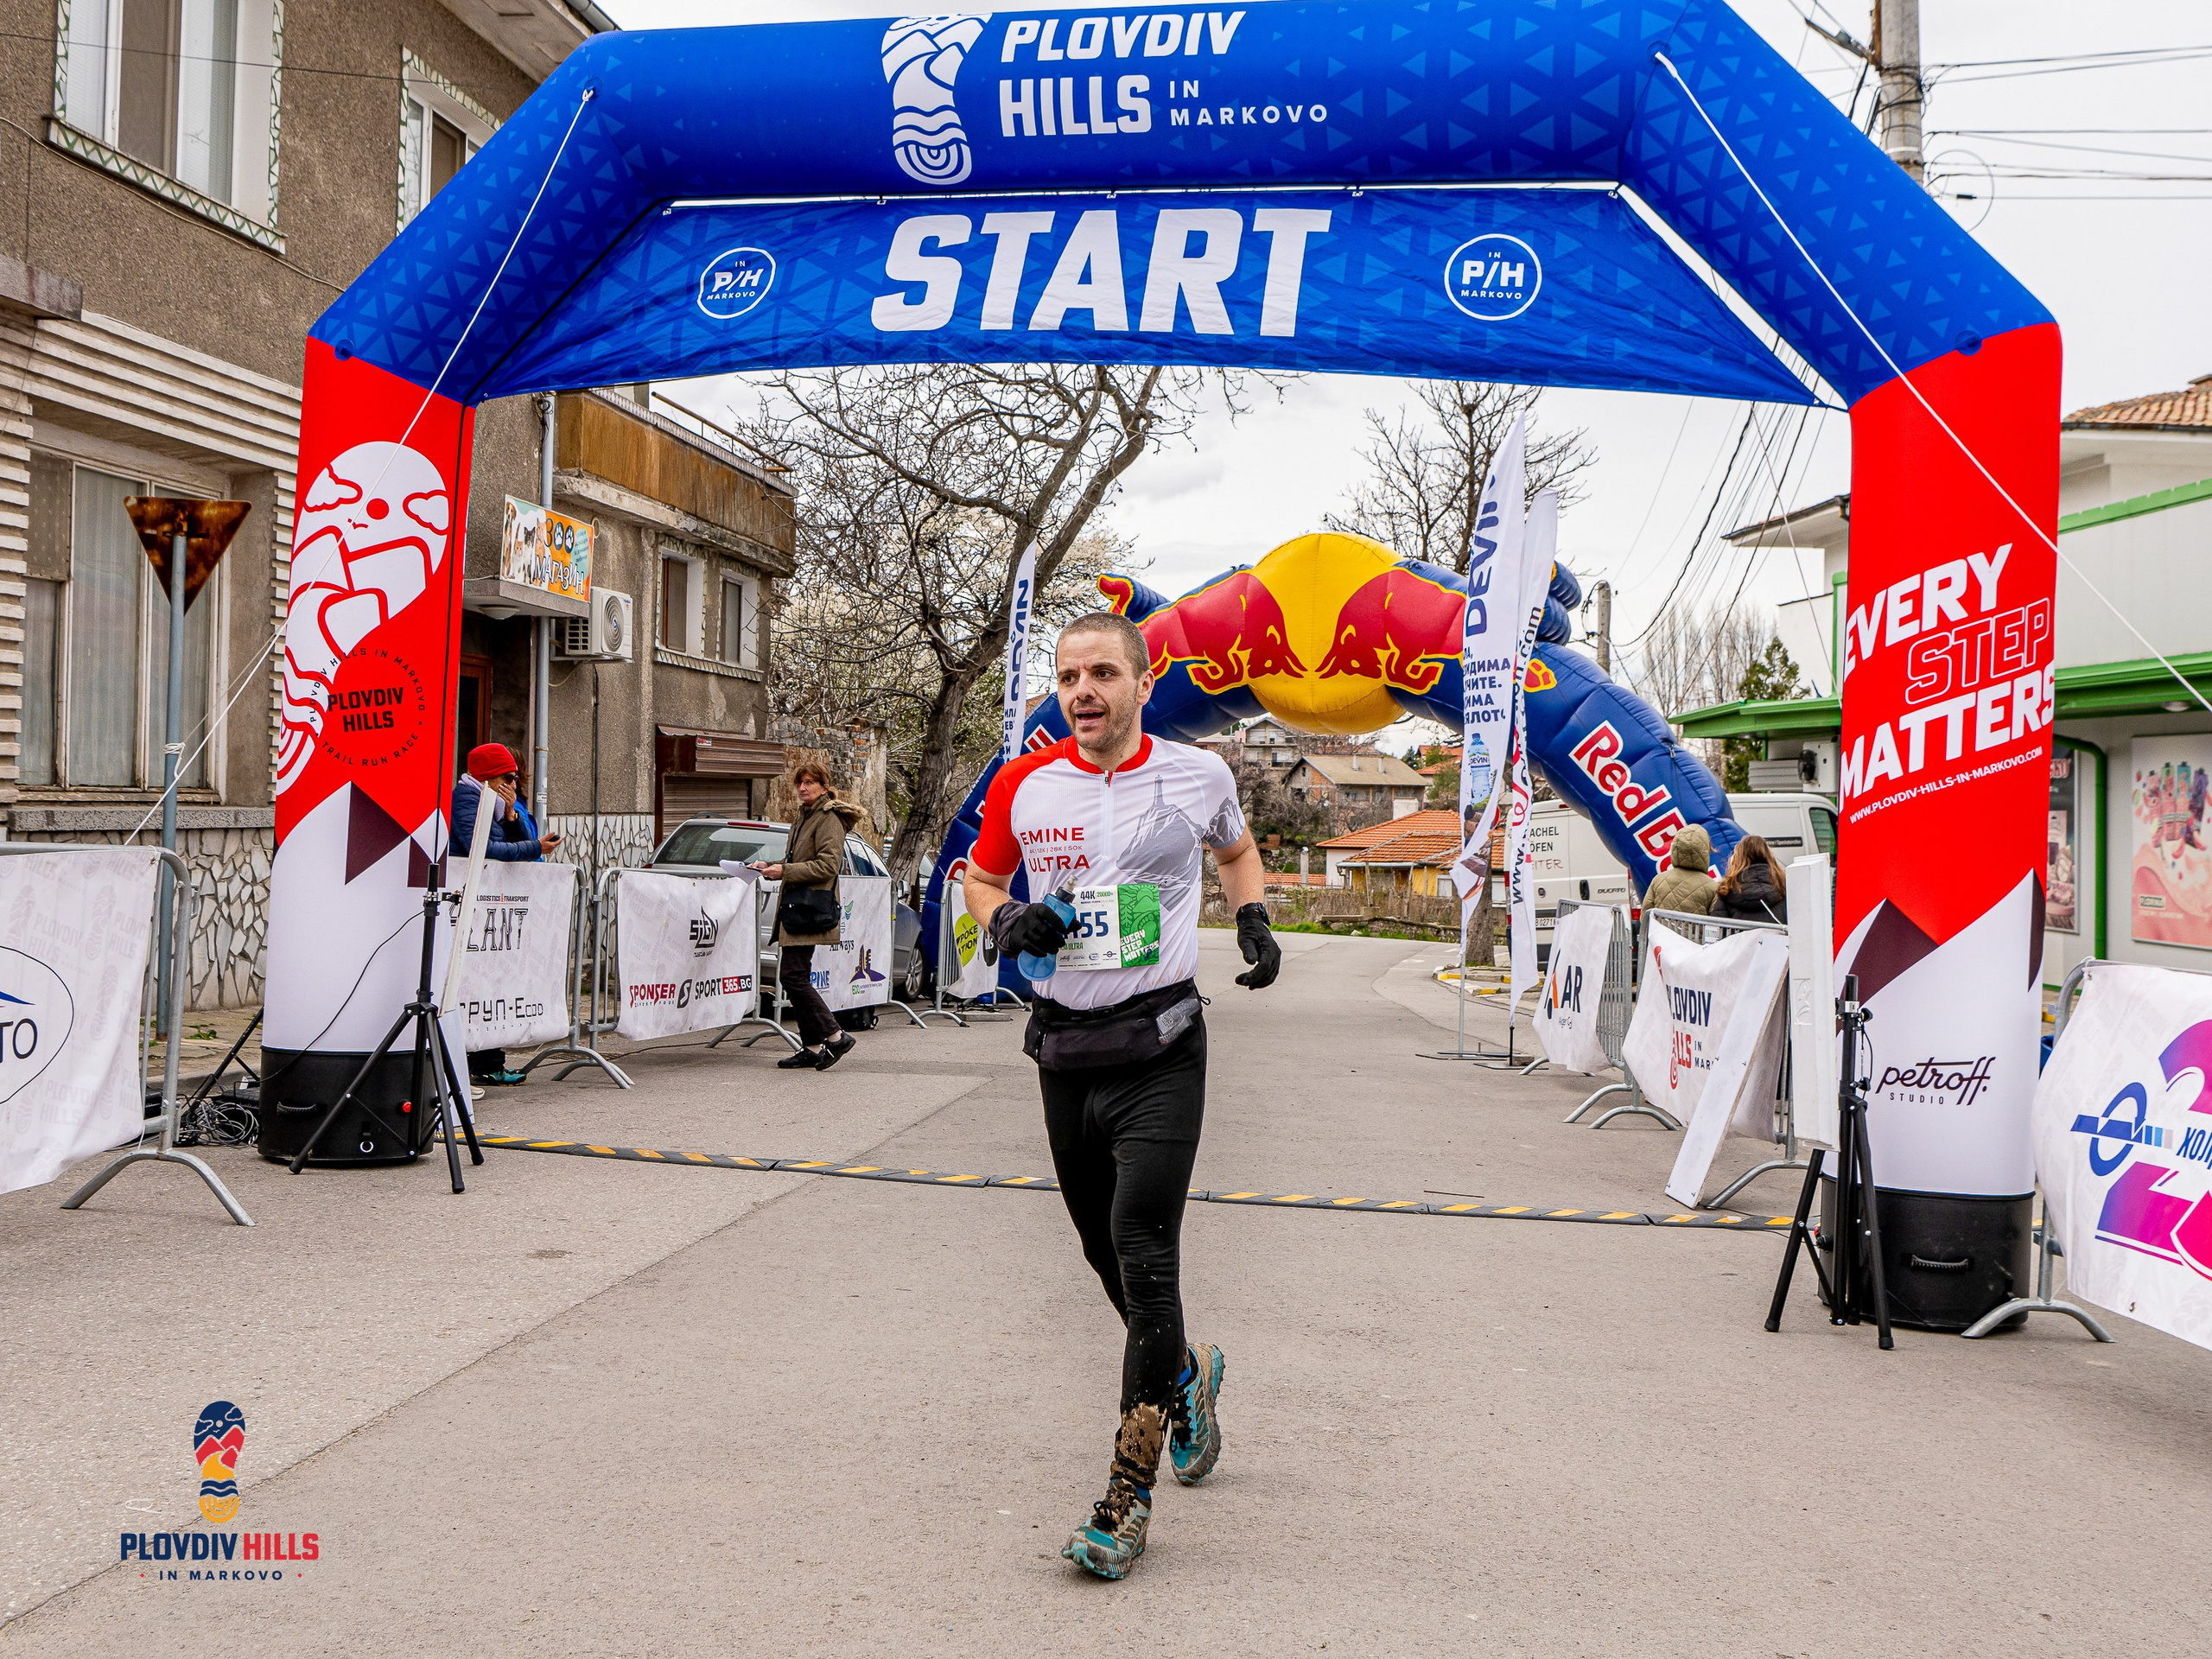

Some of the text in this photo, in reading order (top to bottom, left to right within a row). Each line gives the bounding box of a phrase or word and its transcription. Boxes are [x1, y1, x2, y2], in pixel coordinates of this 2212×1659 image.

[1001, 10, 1246, 63] PLOVDIV
[1169, 79, 1199, 99] IN
[999, 74, 1151, 137] HILLS
[1170, 105, 1328, 127] MARKOVO
[711, 268, 765, 293] P/H
[870, 208, 1332, 337] START
[1461, 259, 1525, 289] P/H
[706, 290, 756, 301] MARKOVO
[1460, 289, 1522, 300] MARKOVO
[535, 554, 585, 594] МАГАЗИН
[1844, 543, 2013, 683] EVERY
[1904, 596, 2050, 705] STEP
[308, 647, 426, 723] PLOVDIV HILLS IN MARKOVO
[327, 687, 404, 712] PLOVDIV
[342, 711, 395, 733] HILLS
[1838, 659, 2055, 814] MATTERS
[321, 733, 419, 766] TRAIL RUN RACE
[1571, 721, 1671, 828] Red
[1849, 746, 2044, 825] WWW.PLOVDIV-HILLS-IN-MARKOVO.COM
[1020, 827, 1085, 846] EMINE
[1027, 854, 1090, 873] ULTRA
[1080, 890, 1096, 900] 44K
[629, 983, 677, 1008] SPONSER
[1694, 1039, 1702, 1052] IN
[1890, 1092, 1944, 1105] STUDIO
